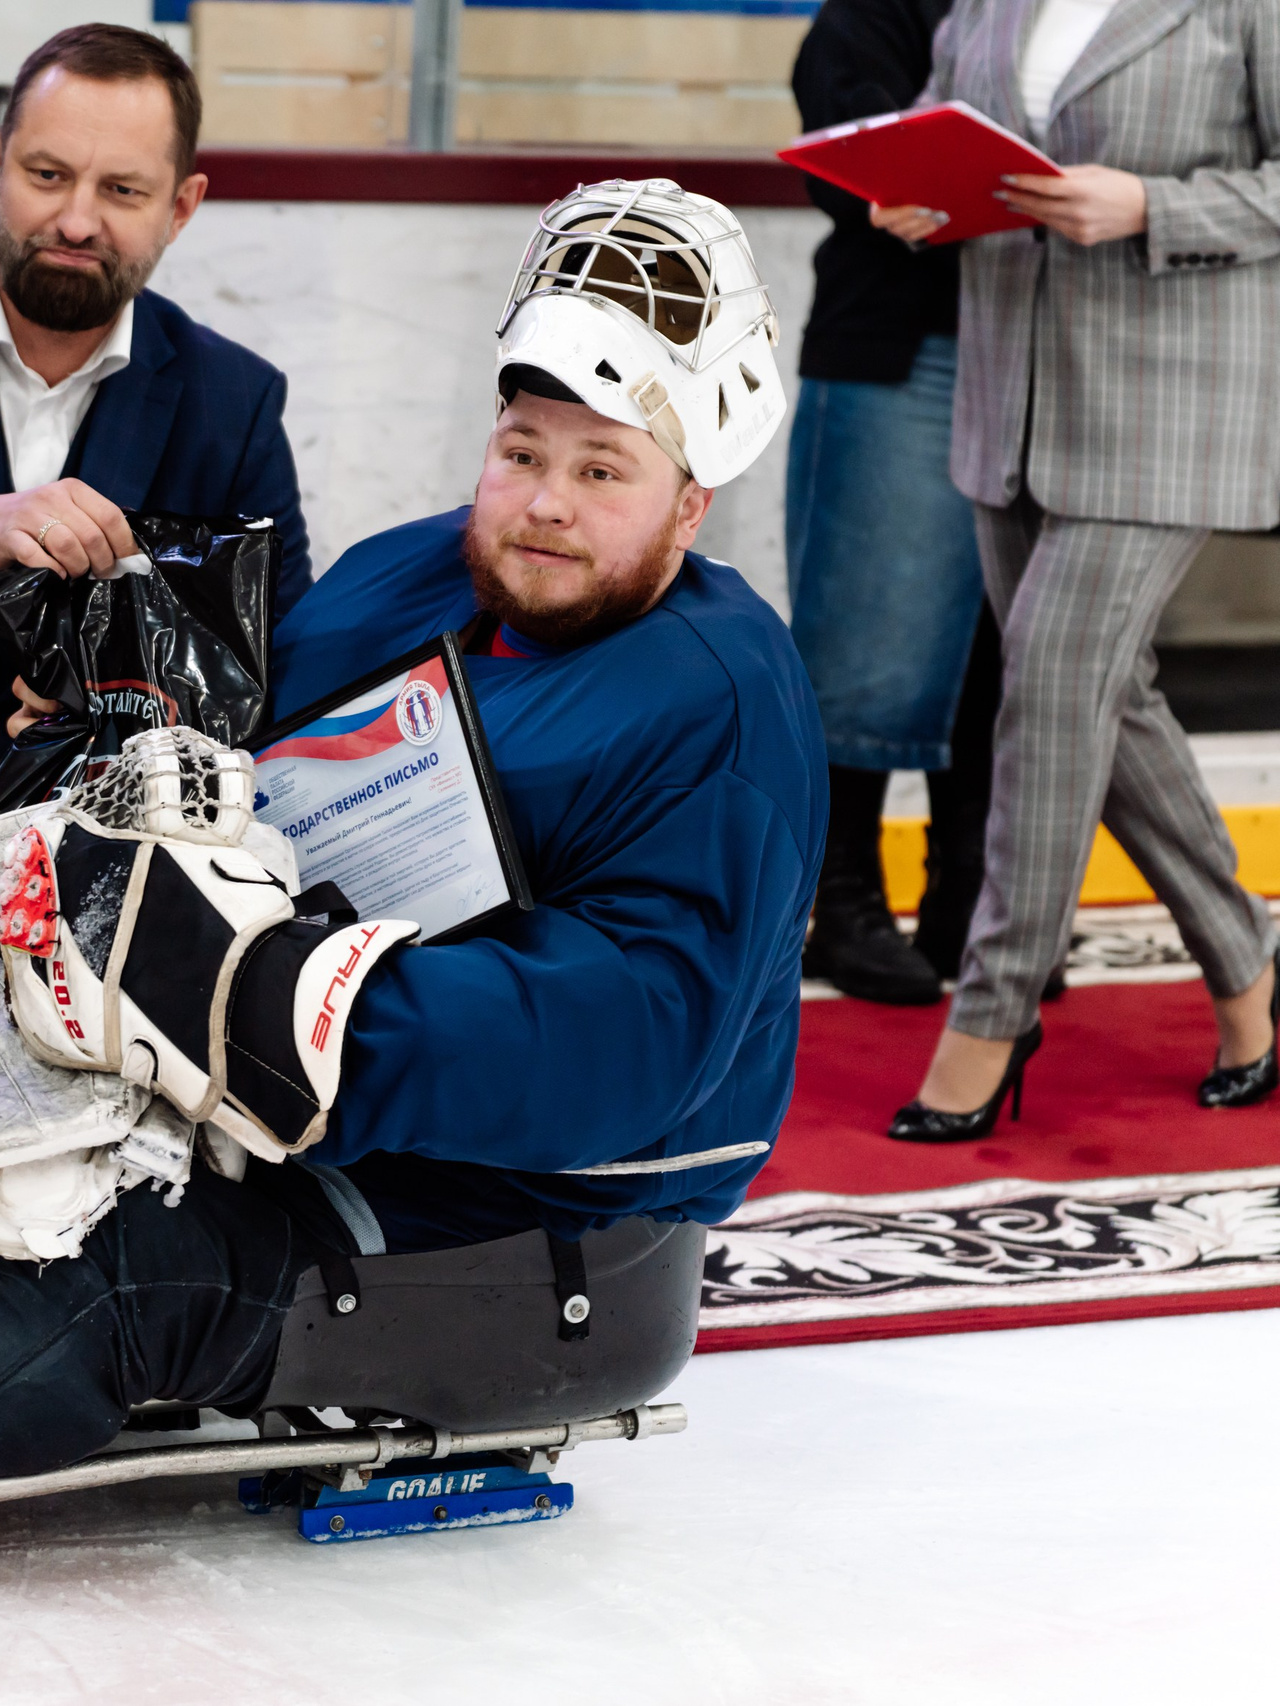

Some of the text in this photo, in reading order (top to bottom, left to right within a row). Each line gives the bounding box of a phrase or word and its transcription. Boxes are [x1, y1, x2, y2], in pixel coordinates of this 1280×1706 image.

[384, 752, 439, 790] ПИСЬМО
[305, 797, 412, 856] Уважаемый Дмитрий Геннадьевич!
[53, 961, 86, 1039] 20.2
[311, 924, 381, 1053] TRUE
